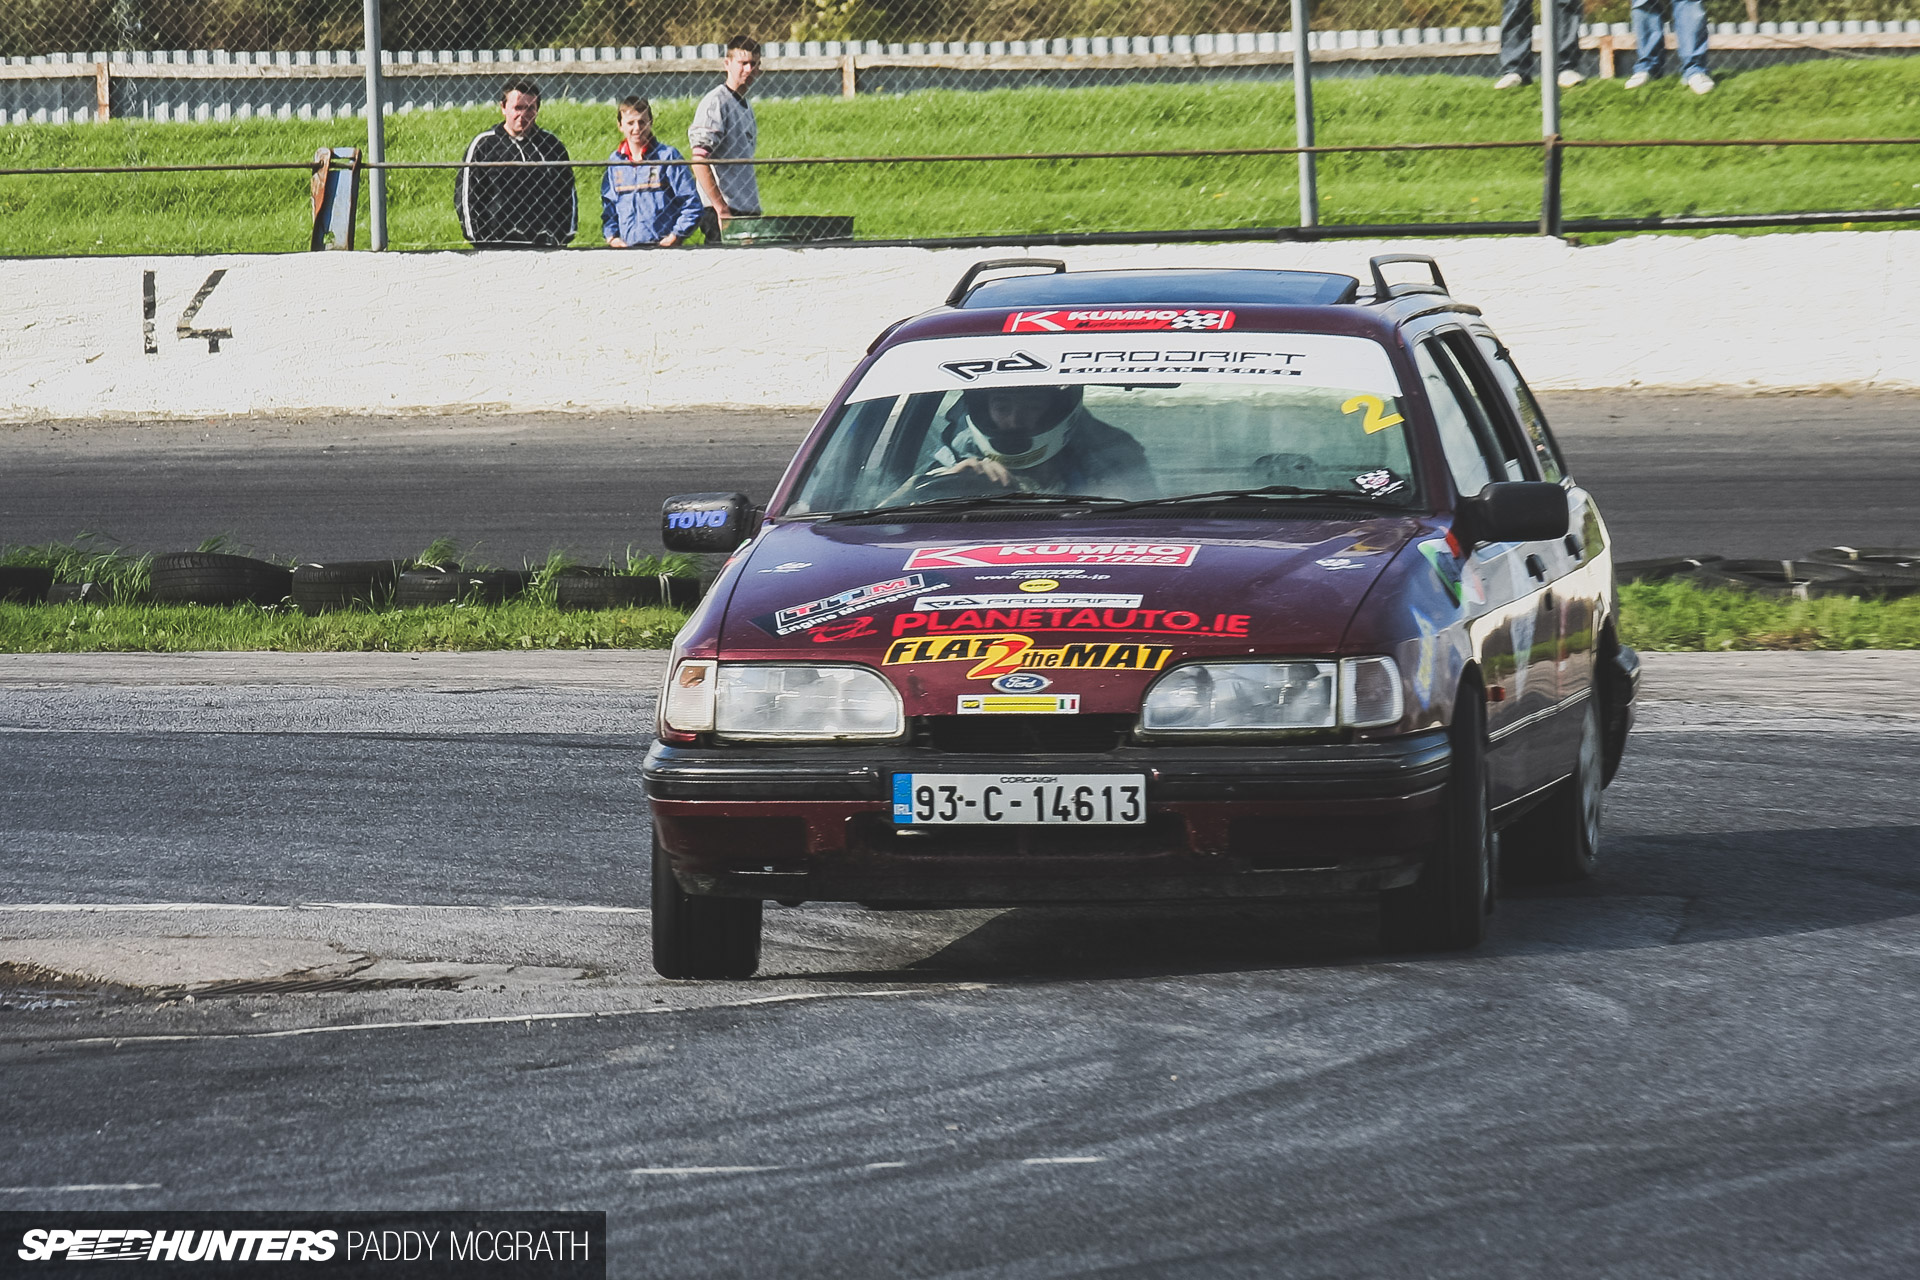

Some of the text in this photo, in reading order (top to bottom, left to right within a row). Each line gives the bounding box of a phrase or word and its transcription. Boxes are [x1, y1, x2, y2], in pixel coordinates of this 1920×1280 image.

[142, 269, 234, 354] 14
[1066, 310, 1179, 322] KUMHO
[1075, 320, 1161, 330] Motorsport
[1060, 351, 1306, 366] PRODRIFT
[1207, 367, 1294, 375] SERIES
[1340, 394, 1405, 435] 2
[998, 545, 1187, 556] KUMHO
[1076, 554, 1182, 564] TYRES
[984, 597, 1139, 606] PRODRIFT
[776, 614, 838, 636] Engine
[838, 582, 951, 616] Management
[892, 608, 1252, 636] PLANETAUTO.IE
[889, 638, 1171, 678] FLAT 2 the MAT
[1005, 676, 1037, 689] Ford
[1000, 776, 1058, 784] CORCAIGH
[893, 804, 913, 815] IRL
